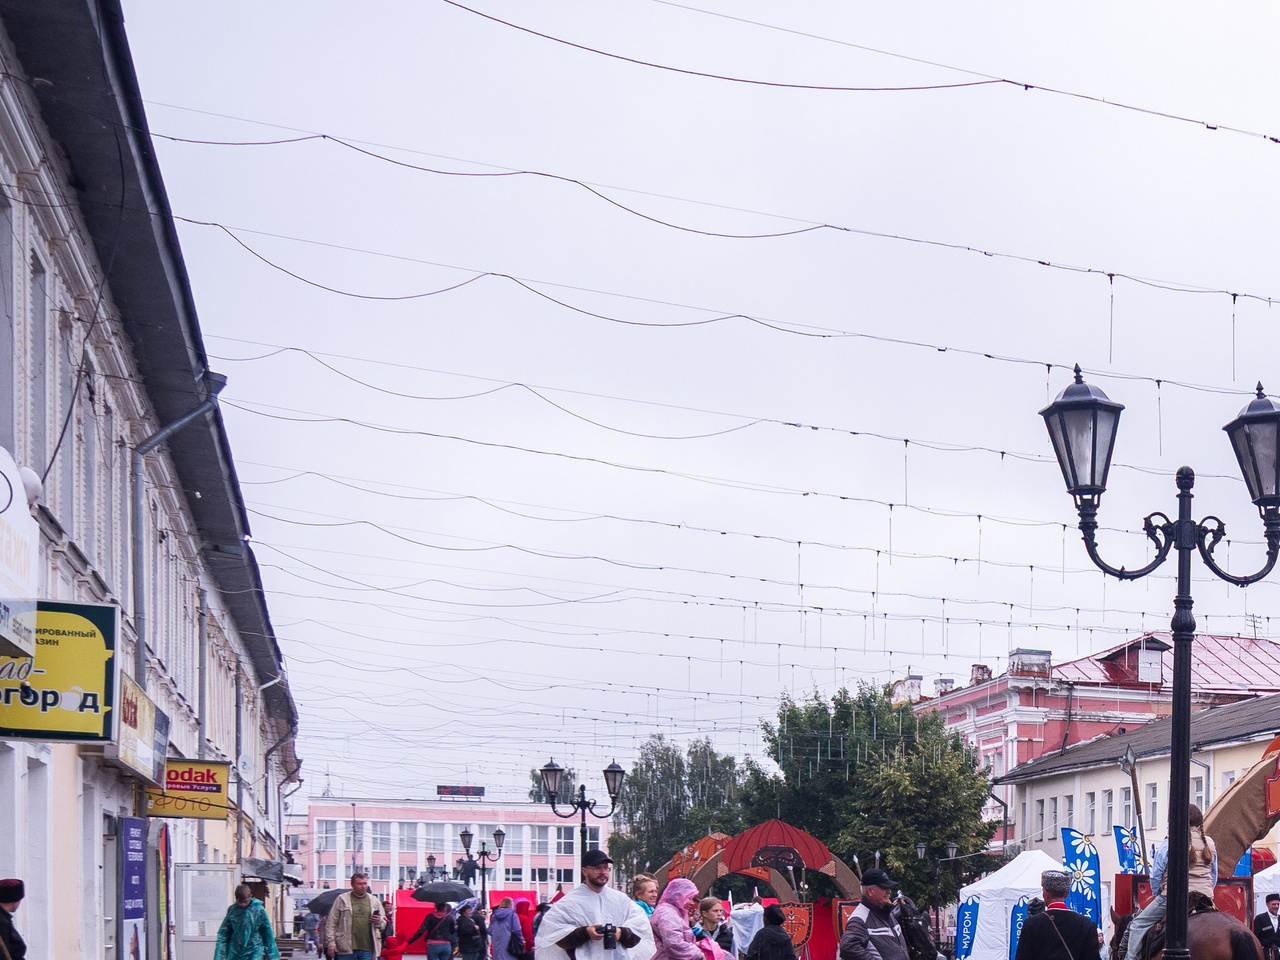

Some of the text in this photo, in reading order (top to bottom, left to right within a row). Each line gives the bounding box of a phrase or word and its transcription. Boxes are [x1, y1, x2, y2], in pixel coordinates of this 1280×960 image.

[165, 767, 218, 783] odak
[155, 795, 212, 812] ФОТО
[962, 911, 972, 949] МУРОМ
[1016, 913, 1024, 946] РОМ
